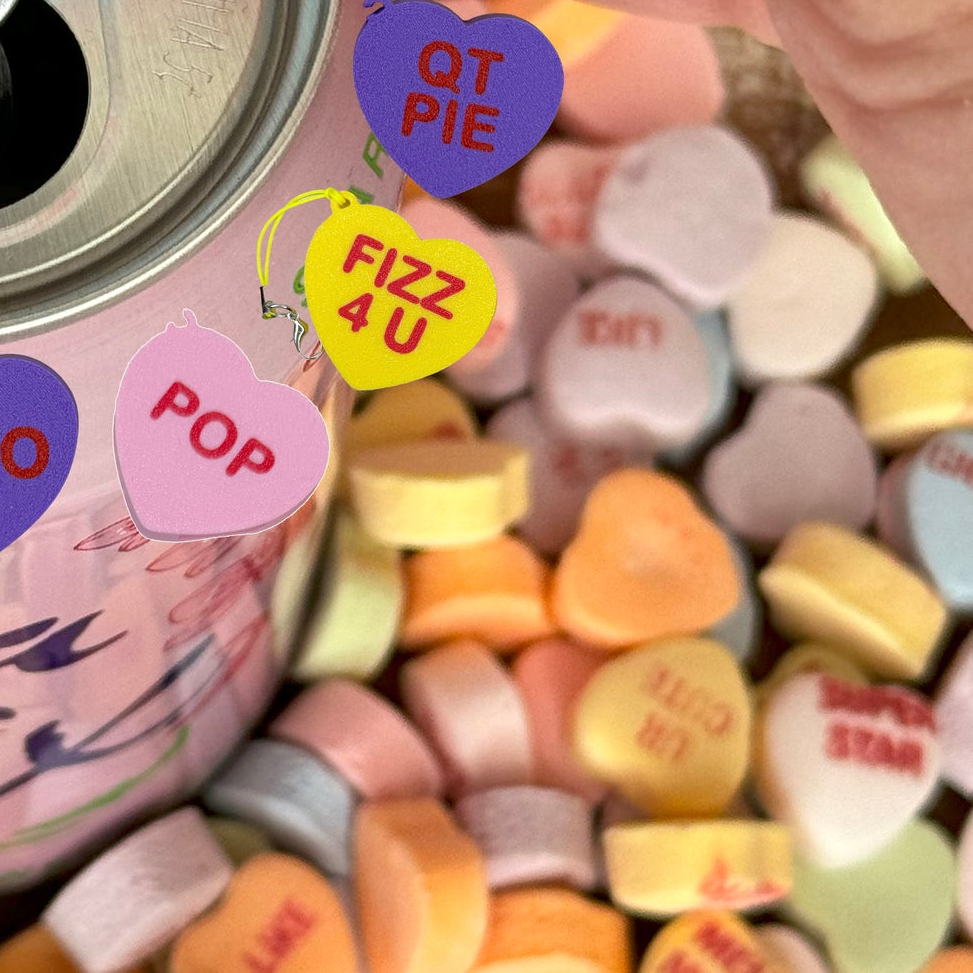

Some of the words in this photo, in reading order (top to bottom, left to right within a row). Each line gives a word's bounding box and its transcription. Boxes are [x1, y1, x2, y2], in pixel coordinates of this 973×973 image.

[417, 39, 506, 96] QT
[400, 91, 502, 154] PIE
[341, 233, 467, 321] FIZZ
[337, 292, 375, 333] 4
[382, 305, 429, 356] U
[149, 380, 276, 477] POP
